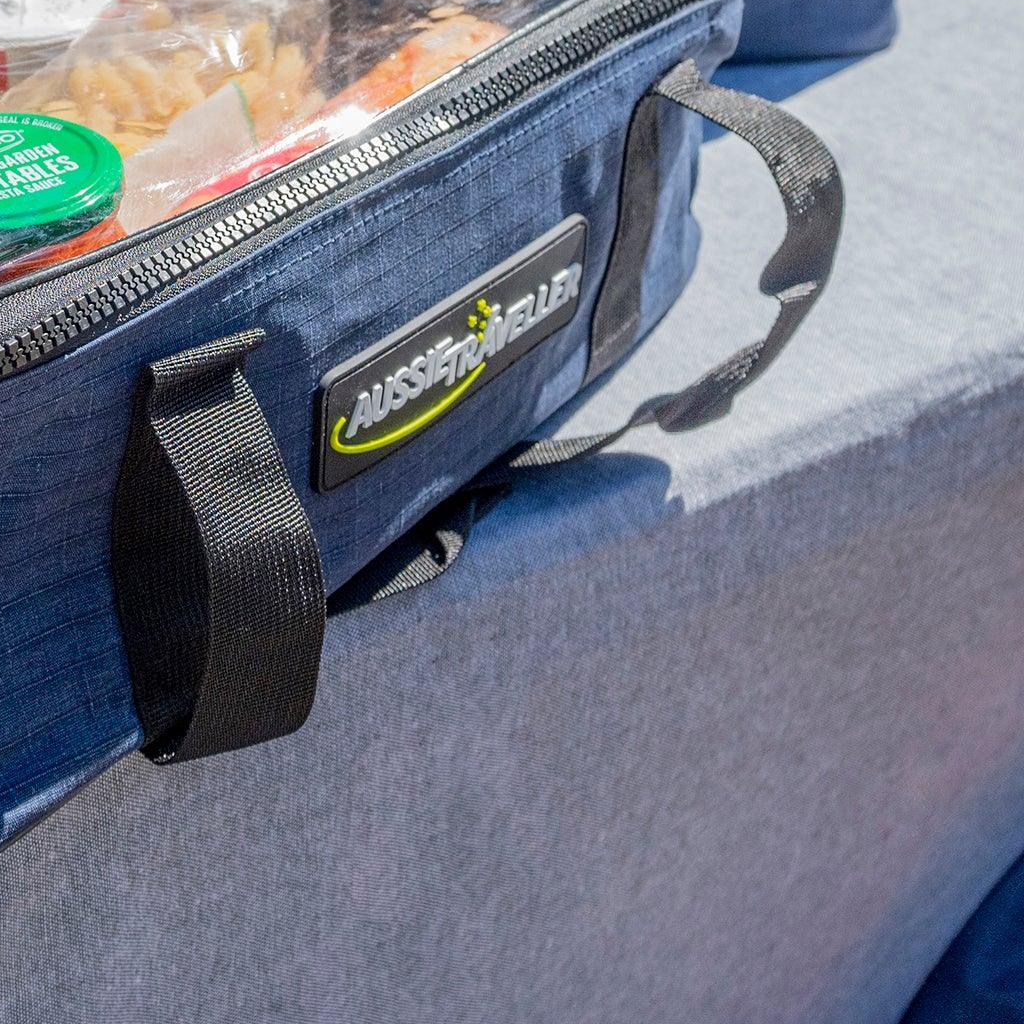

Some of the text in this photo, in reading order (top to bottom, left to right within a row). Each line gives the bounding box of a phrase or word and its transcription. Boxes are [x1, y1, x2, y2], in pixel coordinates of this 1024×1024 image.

[21, 116, 31, 125] IS
[31, 118, 64, 131] BROKEN
[26, 177, 65, 195] SAUCE
